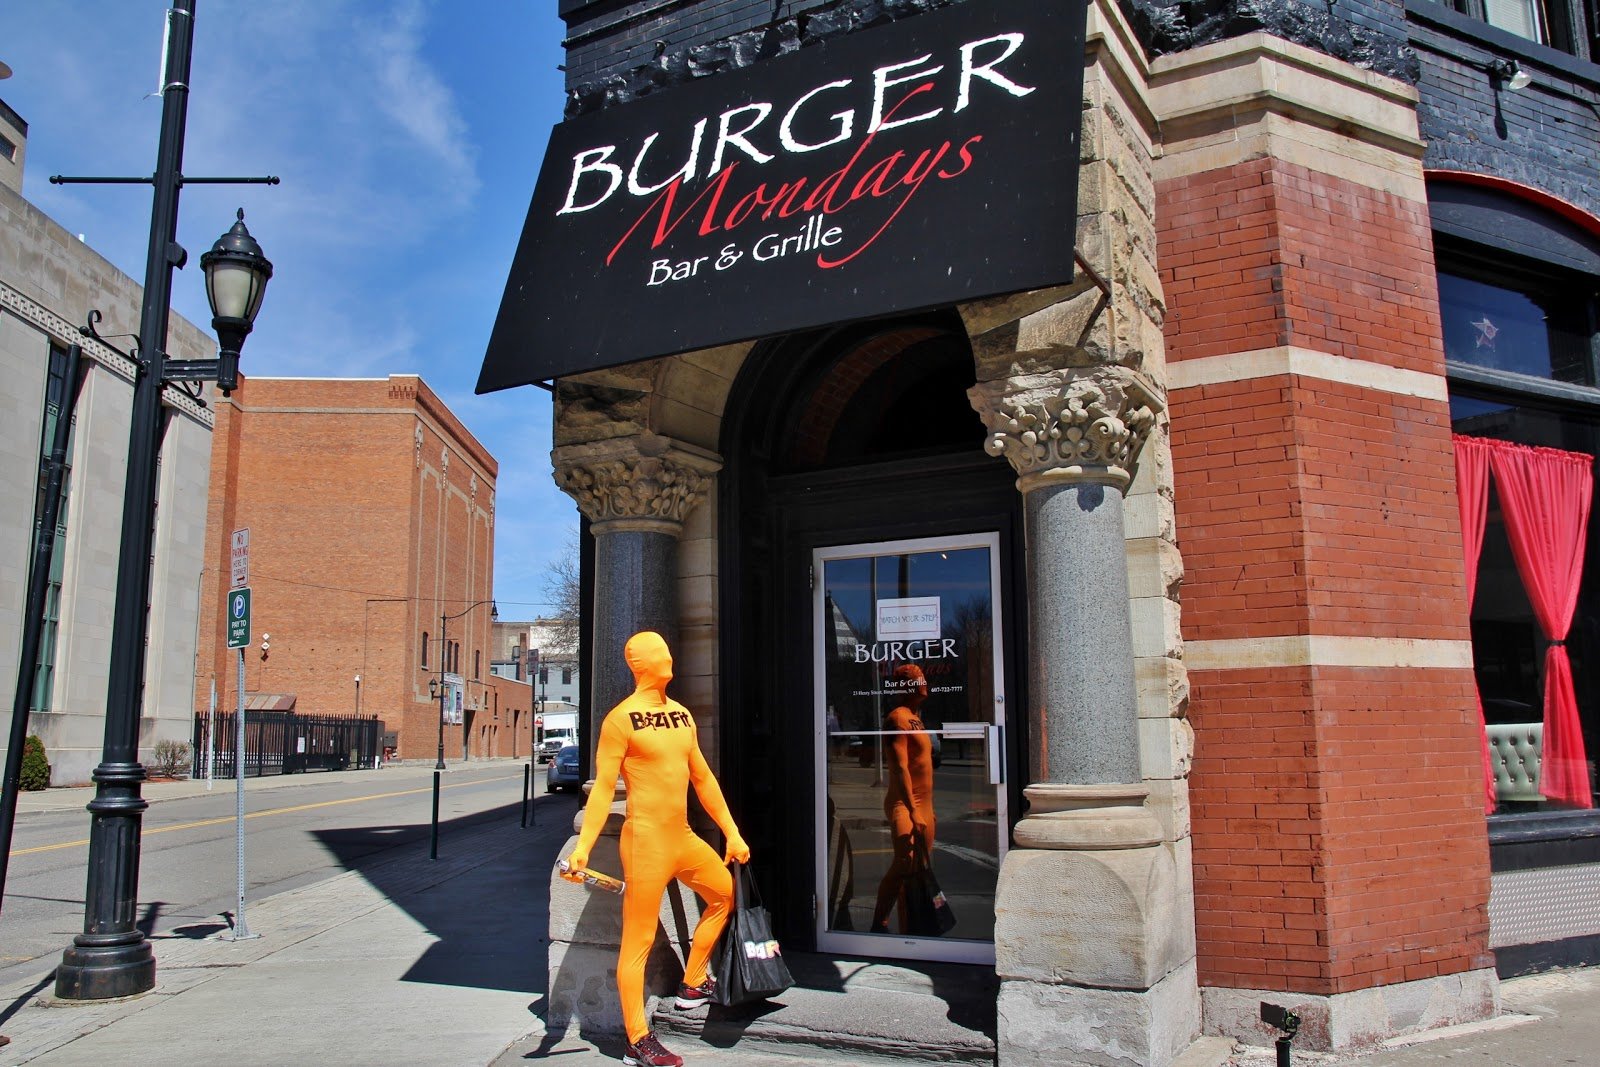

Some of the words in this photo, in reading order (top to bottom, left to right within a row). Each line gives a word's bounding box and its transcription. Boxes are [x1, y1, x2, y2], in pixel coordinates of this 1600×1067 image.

[555, 32, 1036, 216] BURGER
[606, 82, 982, 268] Mondays
[647, 256, 708, 286] Bar
[715, 242, 743, 271] &
[752, 213, 843, 262] Grille
[231, 620, 240, 629] PAY
[240, 619, 247, 628] TO
[233, 628, 245, 637] PARK
[854, 638, 959, 663] BURGER
[884, 679, 897, 688] Bar
[899, 679, 907, 687] &
[907, 677, 927, 687] Grille
